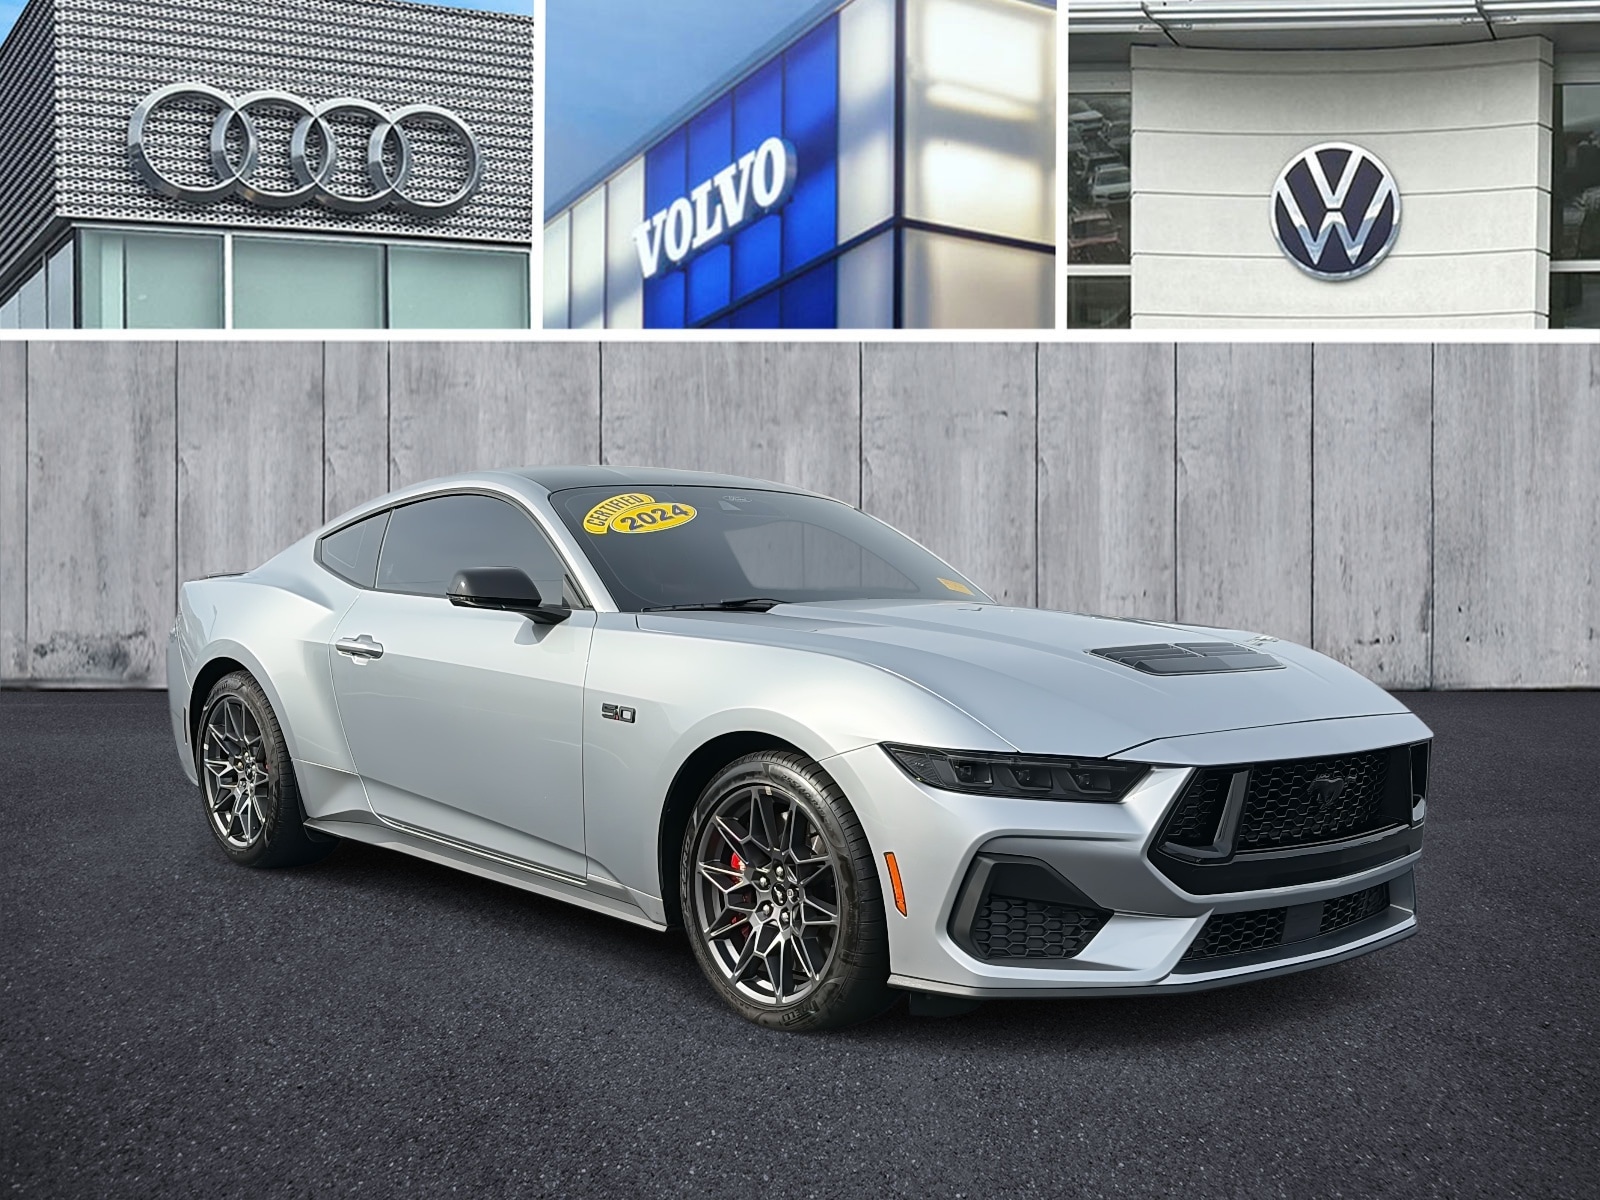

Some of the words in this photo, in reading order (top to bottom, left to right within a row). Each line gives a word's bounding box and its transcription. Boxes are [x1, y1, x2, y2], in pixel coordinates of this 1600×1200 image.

[632, 136, 787, 279] VOLVO
[586, 494, 645, 527] CERTIFIED
[620, 504, 690, 531] 2024
